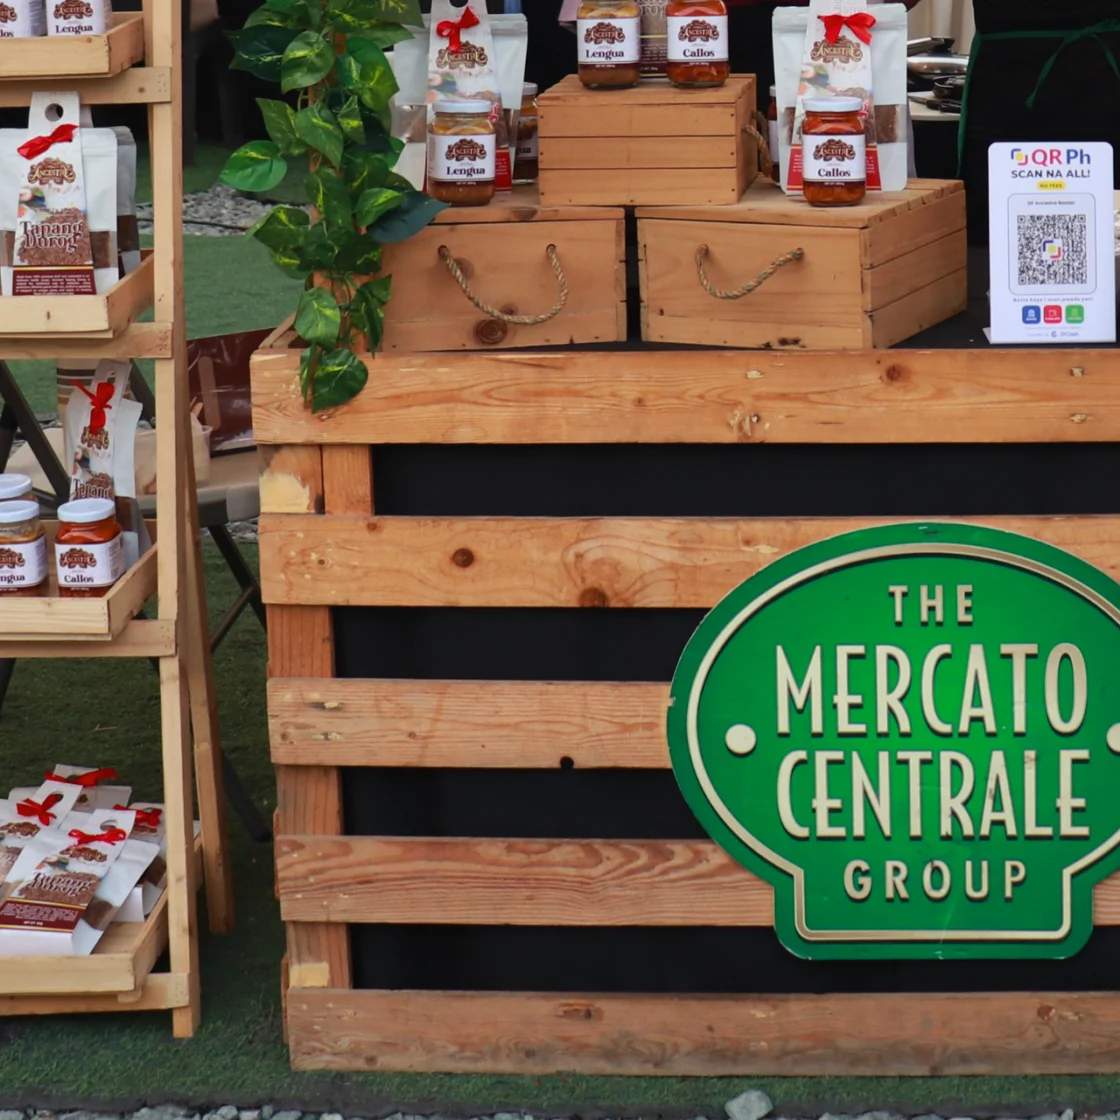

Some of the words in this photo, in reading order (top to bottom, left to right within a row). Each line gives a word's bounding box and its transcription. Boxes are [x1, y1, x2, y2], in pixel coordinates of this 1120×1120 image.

[55, 24, 94, 35] Lengua
[586, 49, 625, 60] Lengua
[683, 48, 715, 57] Callos
[1031, 148, 1063, 166] QR
[1066, 148, 1091, 165] Ph
[446, 166, 486, 177] Lengua
[817, 167, 851, 177] Callos
[1011, 170, 1043, 179] SCAN
[1047, 170, 1064, 178] NA
[1066, 169, 1090, 178] ALL!
[20, 220, 84, 237] Tapang
[24, 232, 79, 253] Durog
[0, 574, 25, 584] ngua
[64, 574, 94, 583] Callos
[888, 584, 975, 624] THE
[776, 642, 1088, 737] MERCATO
[776, 749, 1091, 839] CENTRALE
[843, 859, 1028, 901] GROUP
